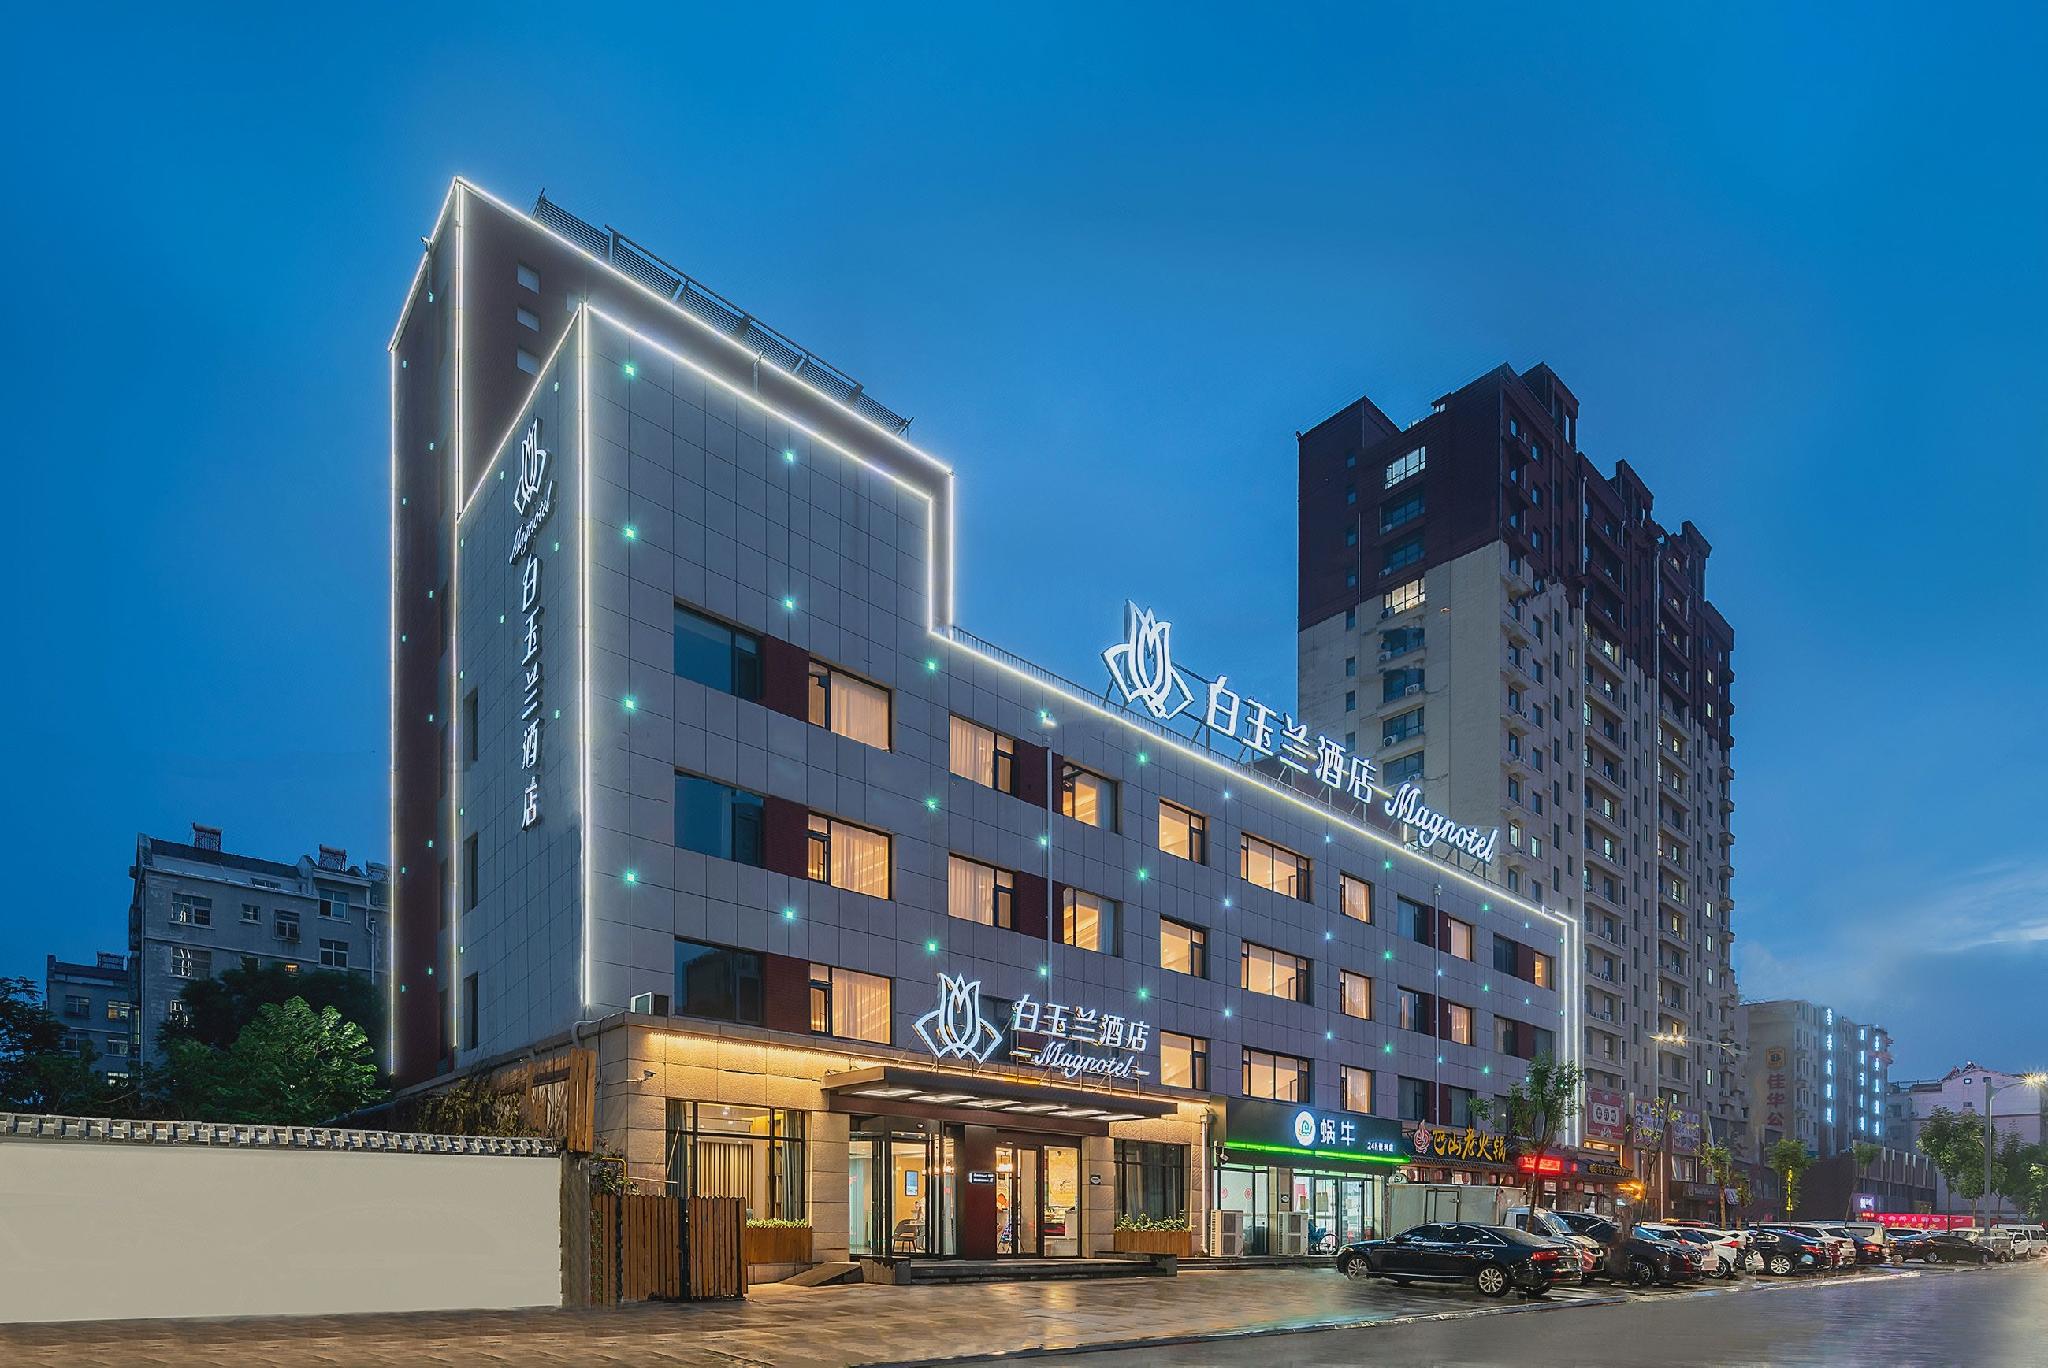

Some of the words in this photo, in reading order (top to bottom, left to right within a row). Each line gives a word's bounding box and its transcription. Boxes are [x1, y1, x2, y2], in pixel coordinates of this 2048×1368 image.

[521, 554, 541, 829] 白玉兰酒店
[1206, 675, 1377, 804] 白玉兰酒店
[1384, 783, 1497, 862] Magnotel
[1011, 994, 1150, 1051] 白玉兰酒店
[1034, 1041, 1134, 1078] Magnotel
[1320, 1118, 1355, 1146] 蜗牛
[1432, 1125, 1506, 1163] 巴山老火锅
